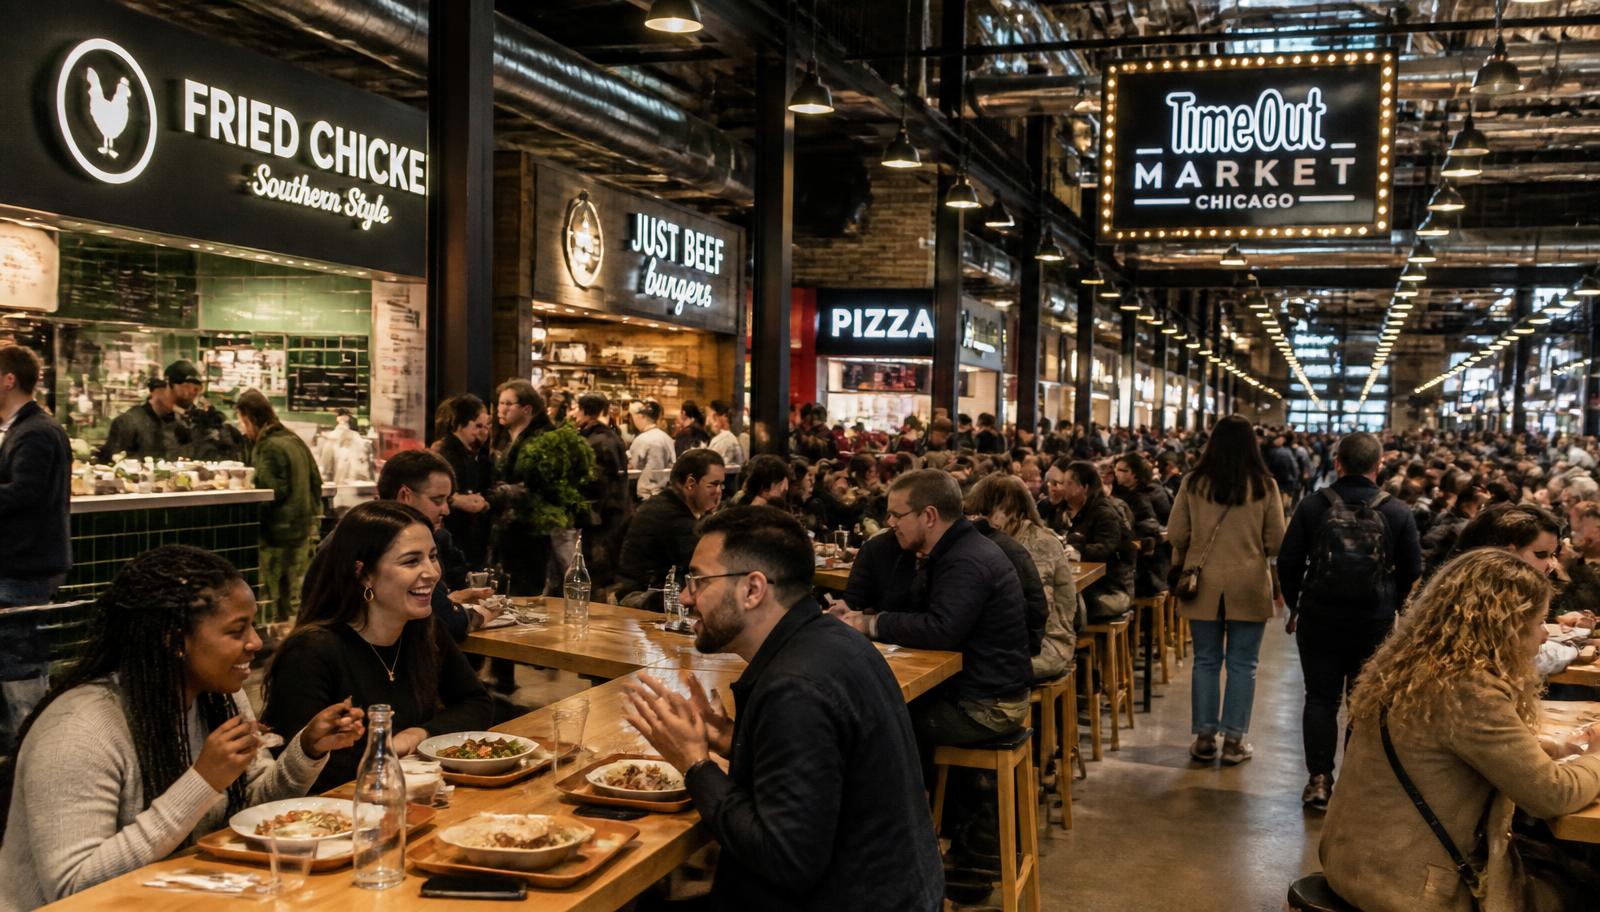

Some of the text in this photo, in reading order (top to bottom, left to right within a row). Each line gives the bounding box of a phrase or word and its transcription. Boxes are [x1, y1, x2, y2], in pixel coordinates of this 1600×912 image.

[184, 78, 429, 196] FRIED CHICKE
[252, 163, 392, 231] Southern Style
[1133, 157, 1356, 190] MARKET
[1195, 193, 1294, 210] CHICAGO
[632, 213, 724, 274] JUST BEEF
[644, 256, 712, 316] burgers
[831, 308, 934, 338] PIZZA
